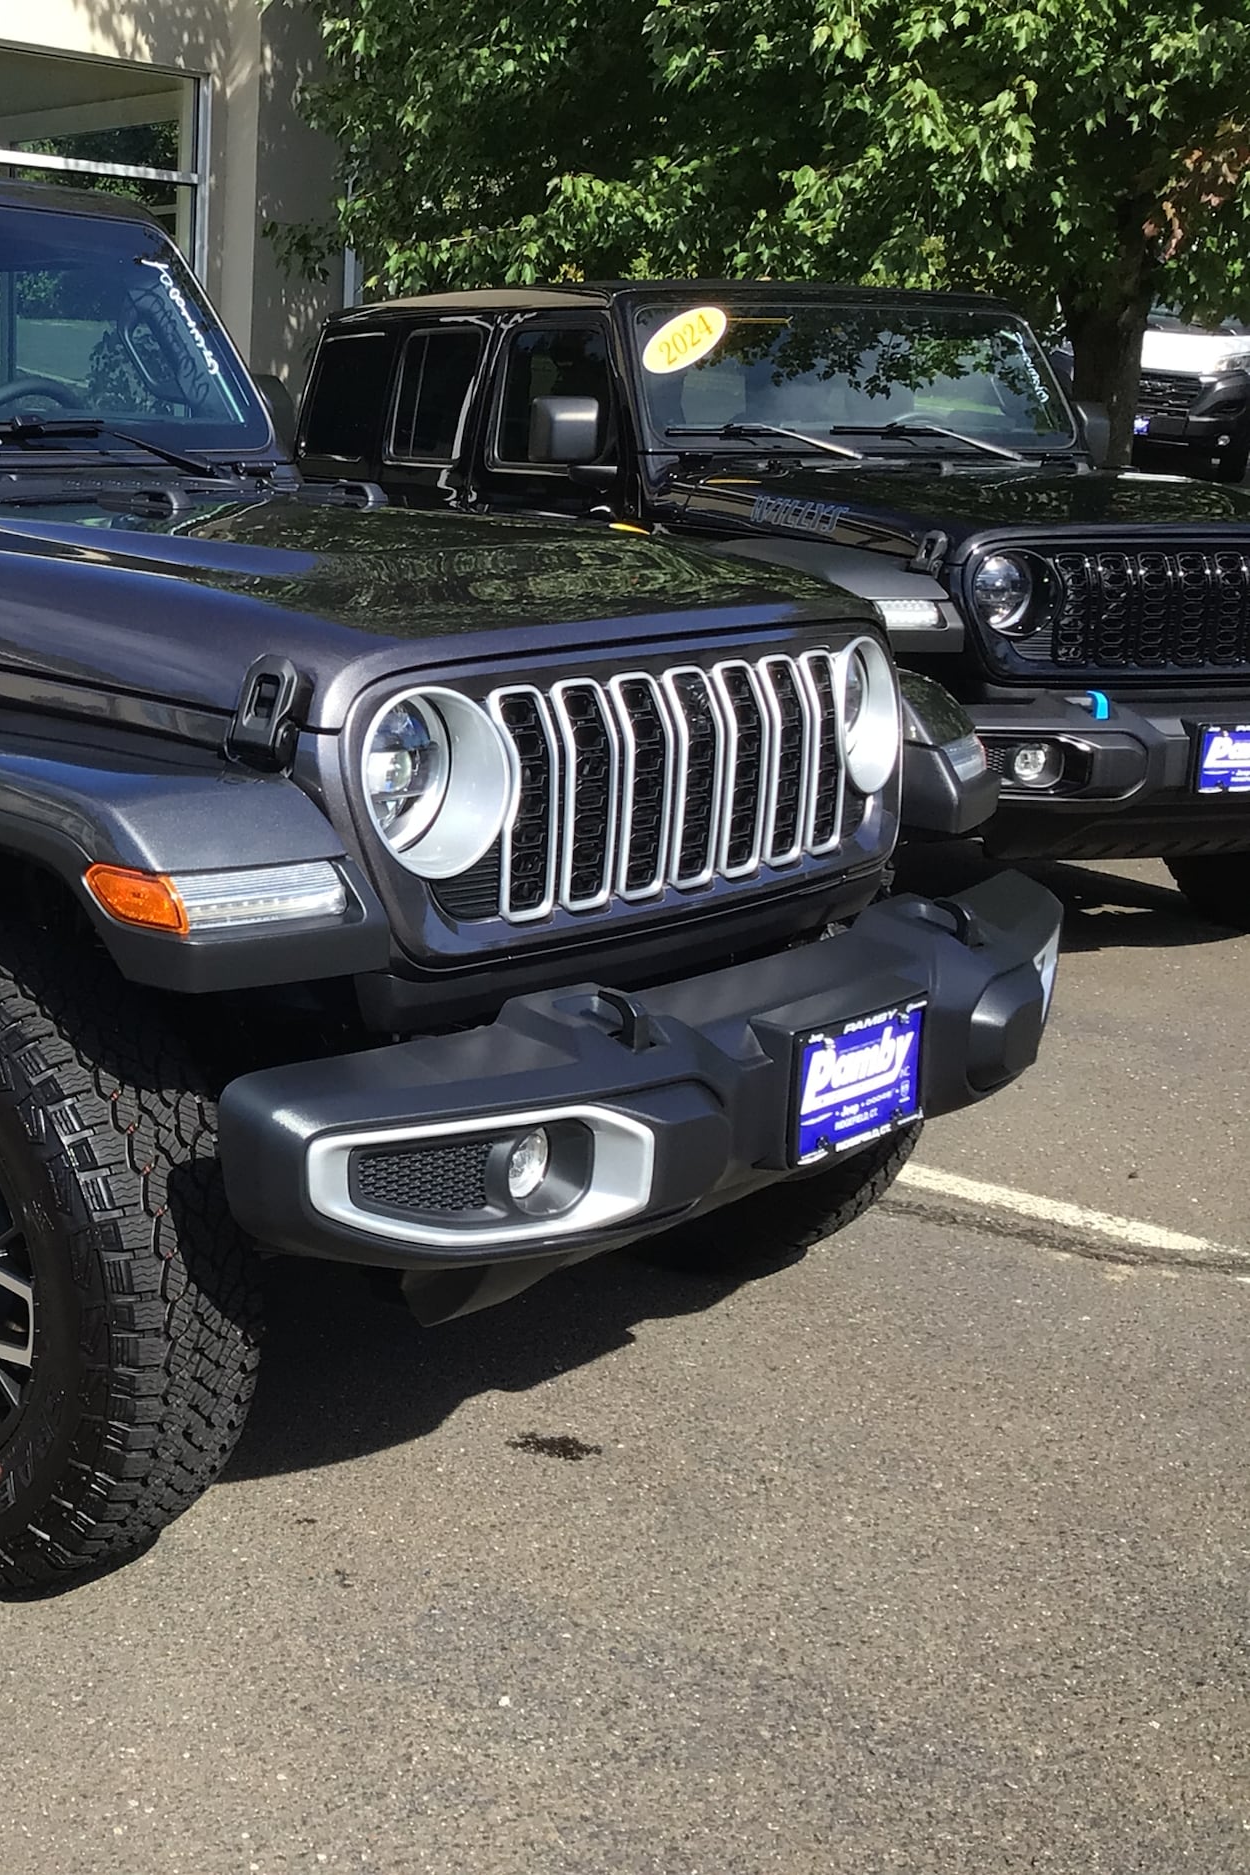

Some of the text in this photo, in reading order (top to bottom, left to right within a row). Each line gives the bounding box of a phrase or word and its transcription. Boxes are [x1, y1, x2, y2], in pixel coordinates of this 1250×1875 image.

[659, 313, 713, 366] 2024
[750, 495, 850, 533] WILLYS
[800, 1026, 915, 1116] Pamby
